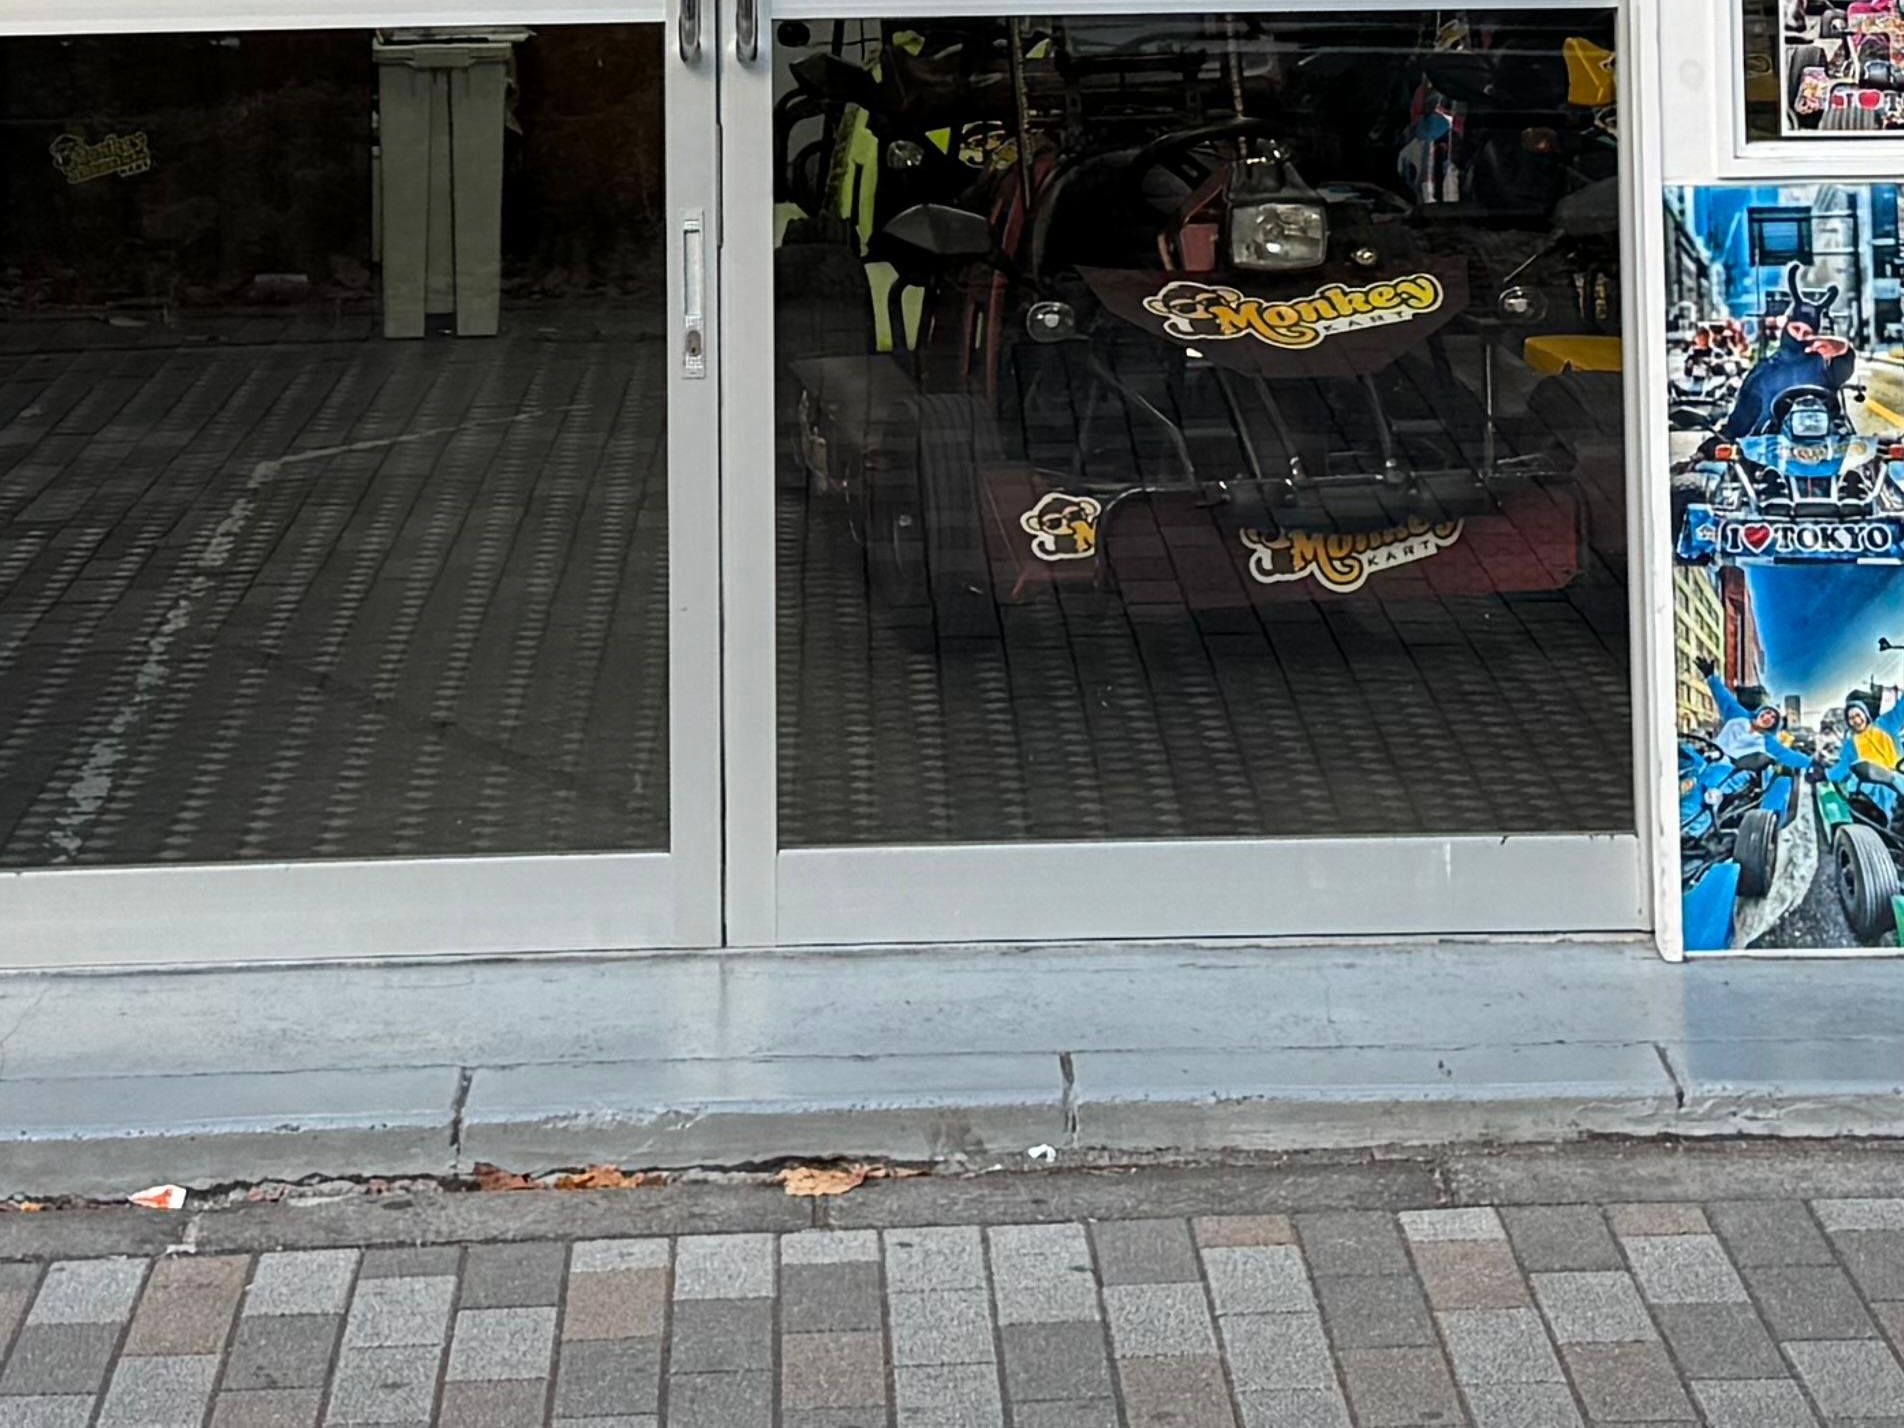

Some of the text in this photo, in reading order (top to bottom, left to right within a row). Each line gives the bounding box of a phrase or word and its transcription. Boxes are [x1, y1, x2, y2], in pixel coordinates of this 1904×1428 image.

[1212, 273, 1436, 344] Monkey
[1323, 309, 1412, 333] KART
[1728, 524, 1891, 548] I TOKYO
[1366, 540, 1434, 567] KART
